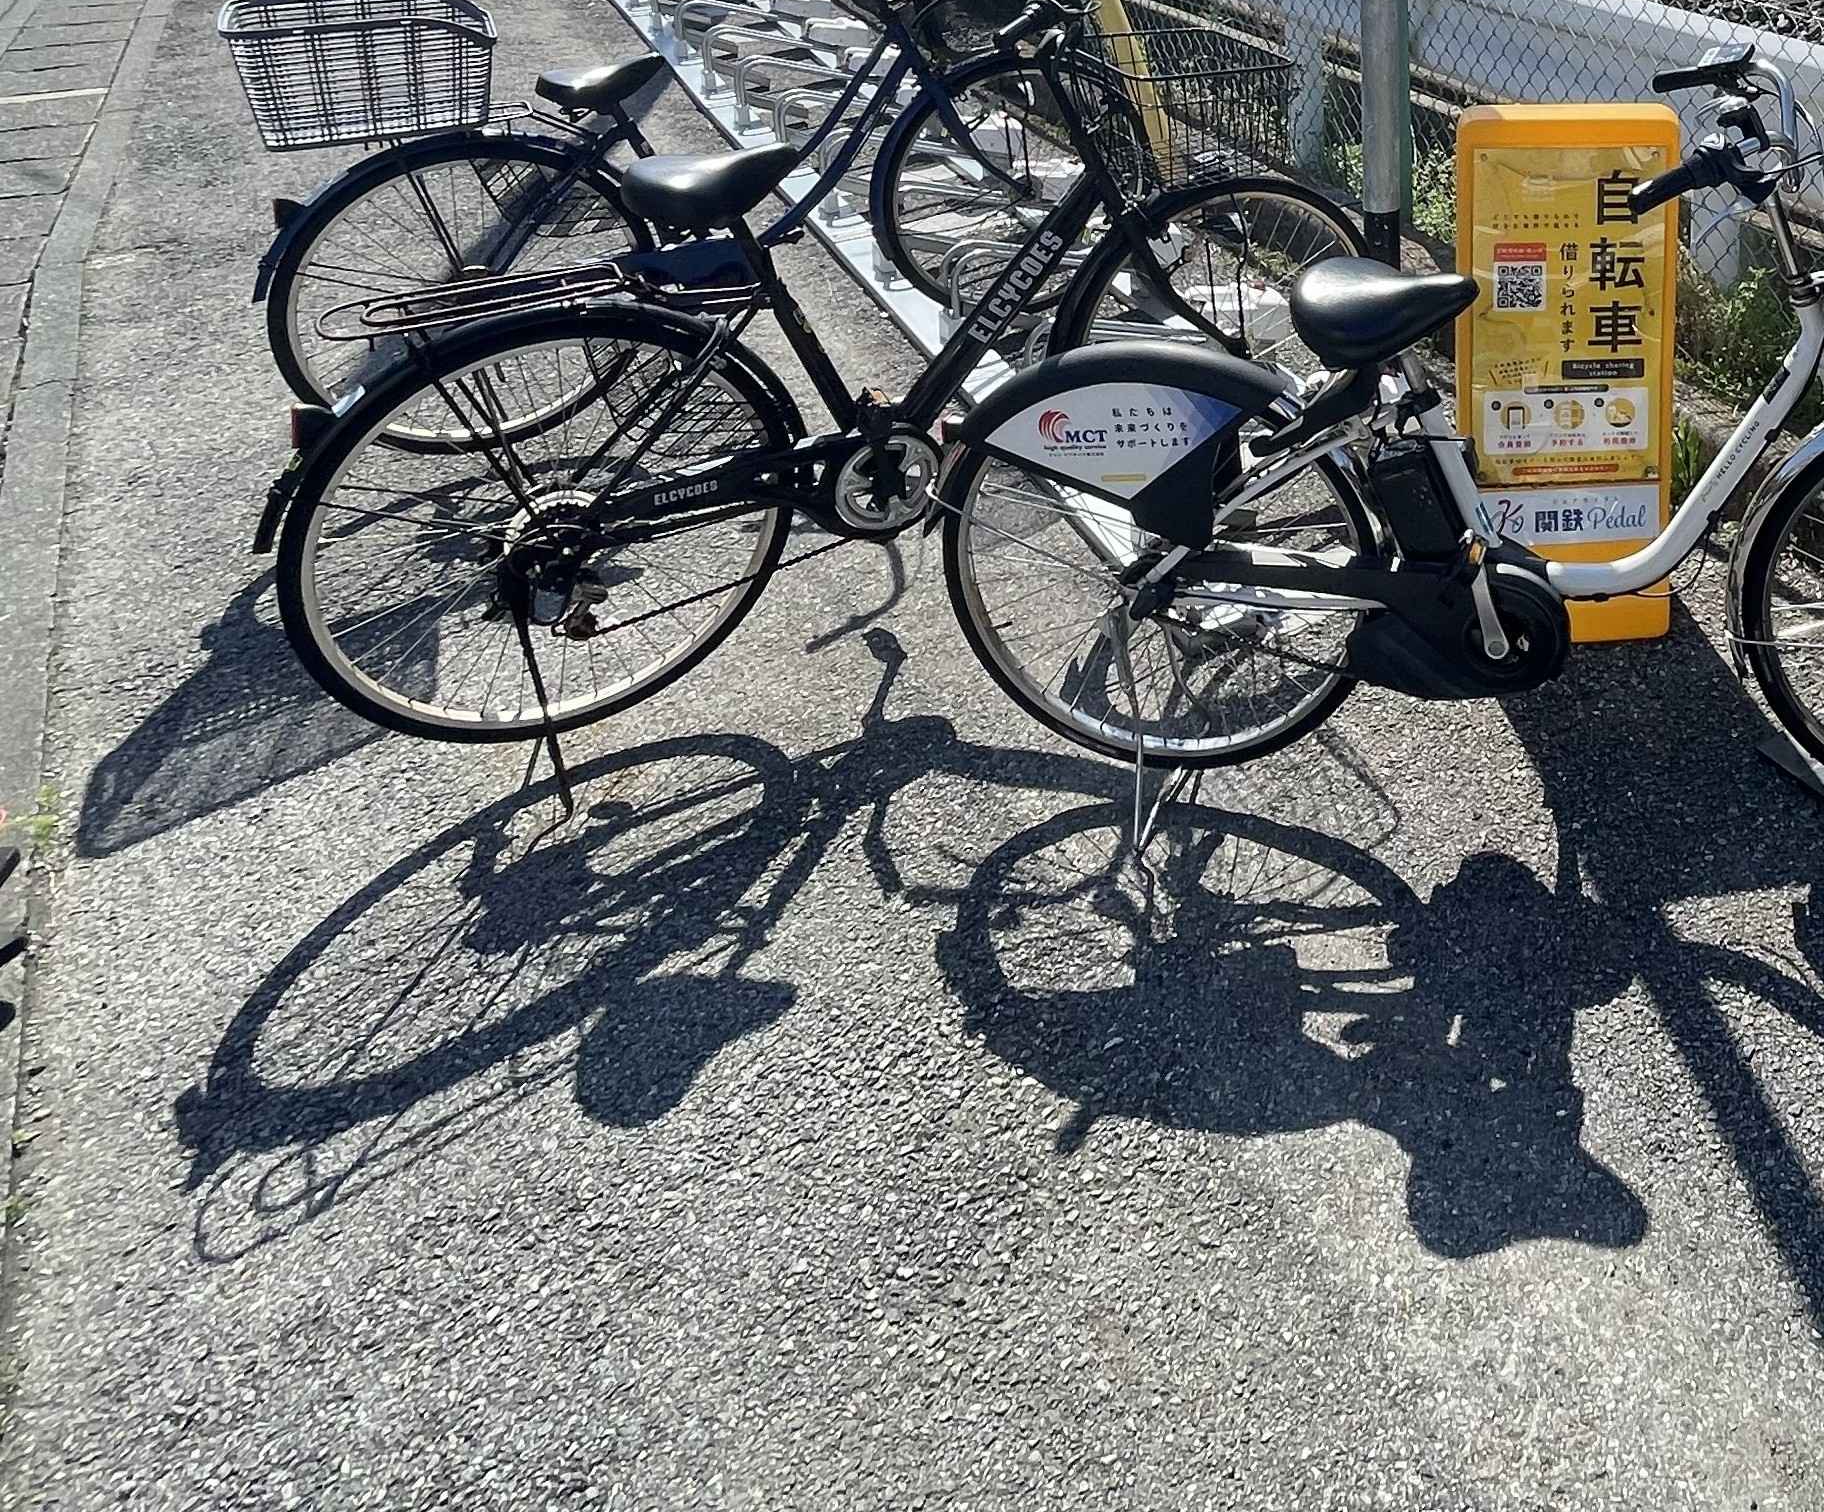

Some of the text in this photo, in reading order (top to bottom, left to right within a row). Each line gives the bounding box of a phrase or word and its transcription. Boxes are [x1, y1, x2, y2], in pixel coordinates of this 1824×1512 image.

[967, 229, 1064, 345] ELCYCOES
[1587, 169, 1646, 353] 自転車
[1559, 242, 1580, 353] 借りられます
[1065, 429, 1108, 444] MCT
[653, 479, 719, 506] ELCYCOES
[1587, 504, 1648, 530] Pedal
